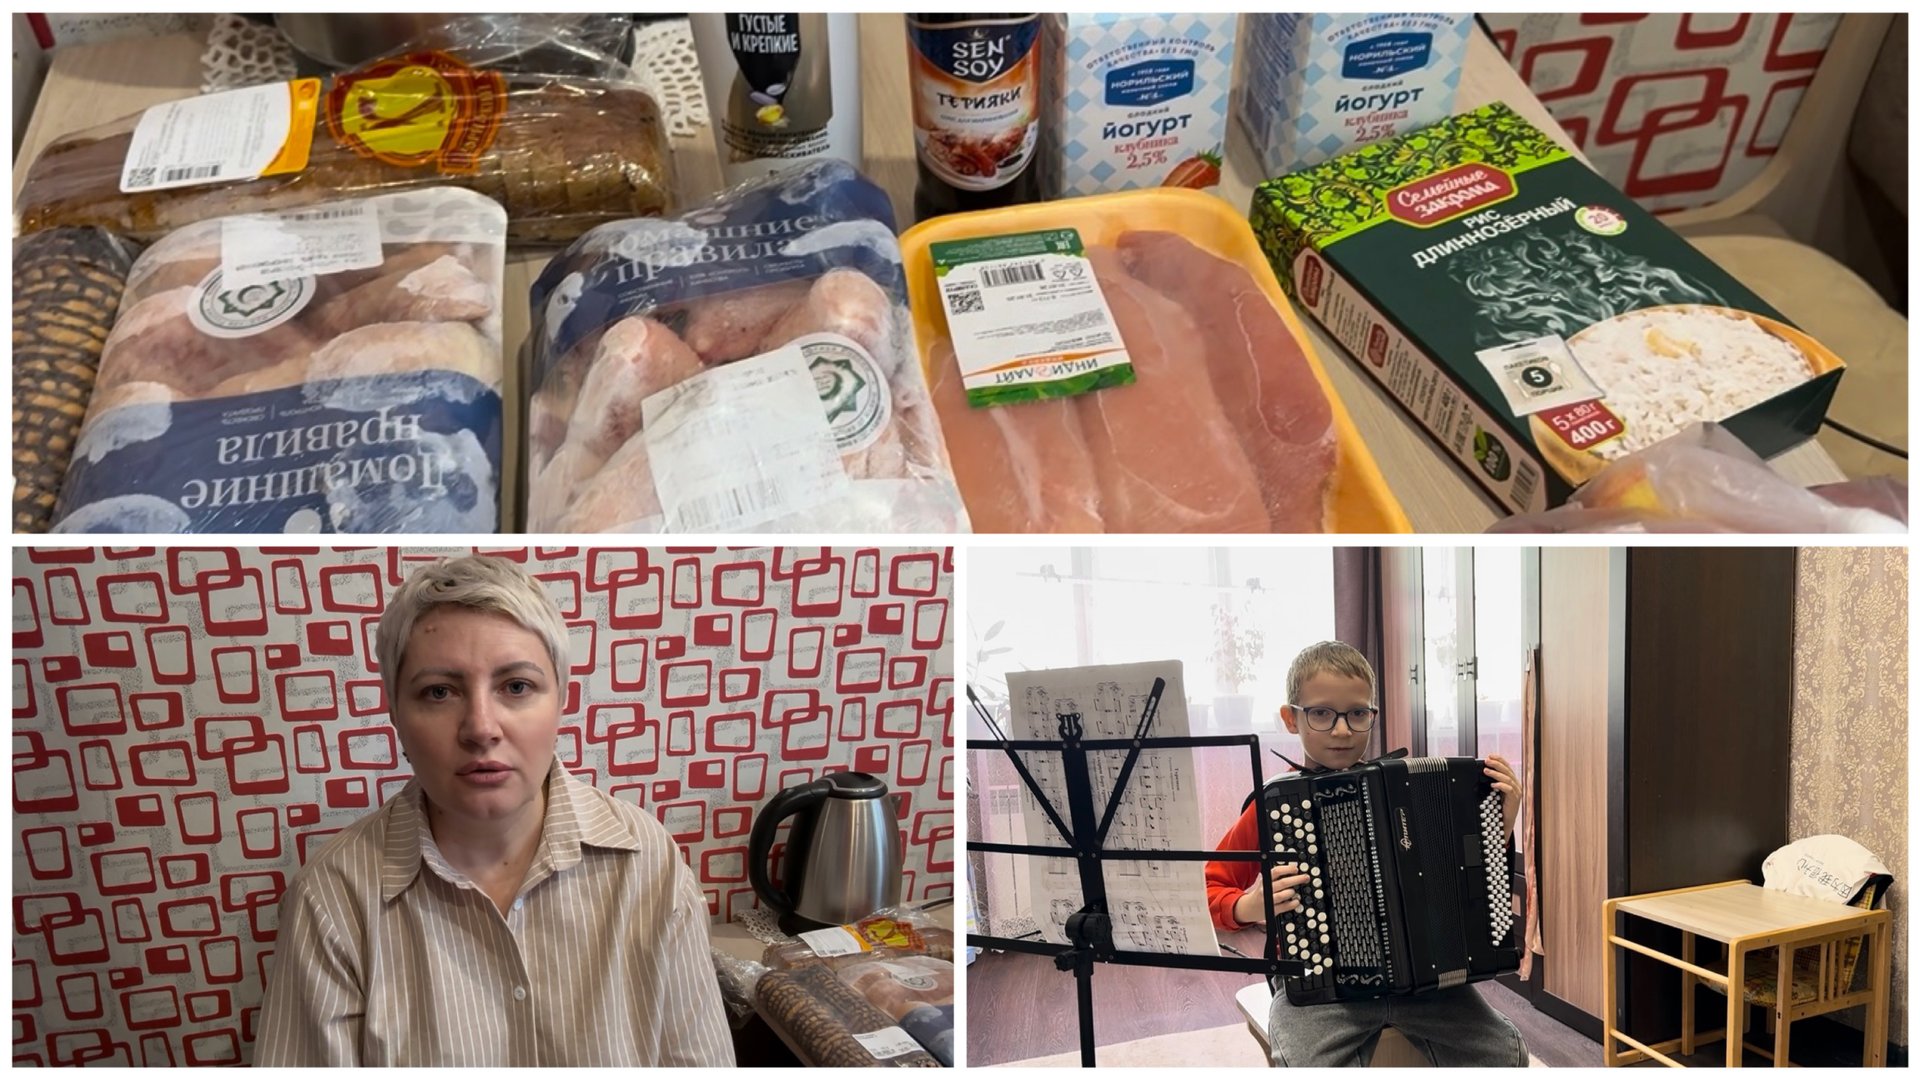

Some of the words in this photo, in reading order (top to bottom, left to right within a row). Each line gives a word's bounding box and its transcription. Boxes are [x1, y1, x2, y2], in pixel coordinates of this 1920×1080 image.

[738, 13, 787, 32] ГУСТЫЕ
[731, 32, 741, 51] И
[742, 33, 799, 54] КРЕПКИЕ
[952, 35, 1005, 59] SEN
[1169, 37, 1216, 53] КОНТРОЛЬ
[1349, 44, 1426, 62] НОРИЛЬСКИЙ
[953, 56, 1004, 79] SOY
[1111, 70, 1189, 89] НОРИЛЬСКИЙ
[936, 86, 1022, 109] ТЕРИЯКИ
[1334, 87, 1424, 113] йогурт
[1102, 114, 1192, 140] йогурт
[1344, 109, 1409, 128] клубника
[1354, 123, 1396, 143] 2,5%
[1114, 136, 1179, 154] клубника
[1126, 150, 1168, 169] 2,5%
[1396, 168, 1488, 208] Семейные
[1462, 210, 1502, 229] РИС
[1588, 212, 1609, 225] 20
[1411, 196, 1577, 268] ДЛИННОЗЁРНЫЙ
[1530, 369, 1545, 383] 5
[1552, 415, 1571, 431] 5
[1572, 404, 1591, 417] 80
[1570, 421, 1608, 445] 400
[1605, 417, 1617, 430] г
[1483, 450, 1499, 474] 100
[179, 449, 450, 512] Домашние
